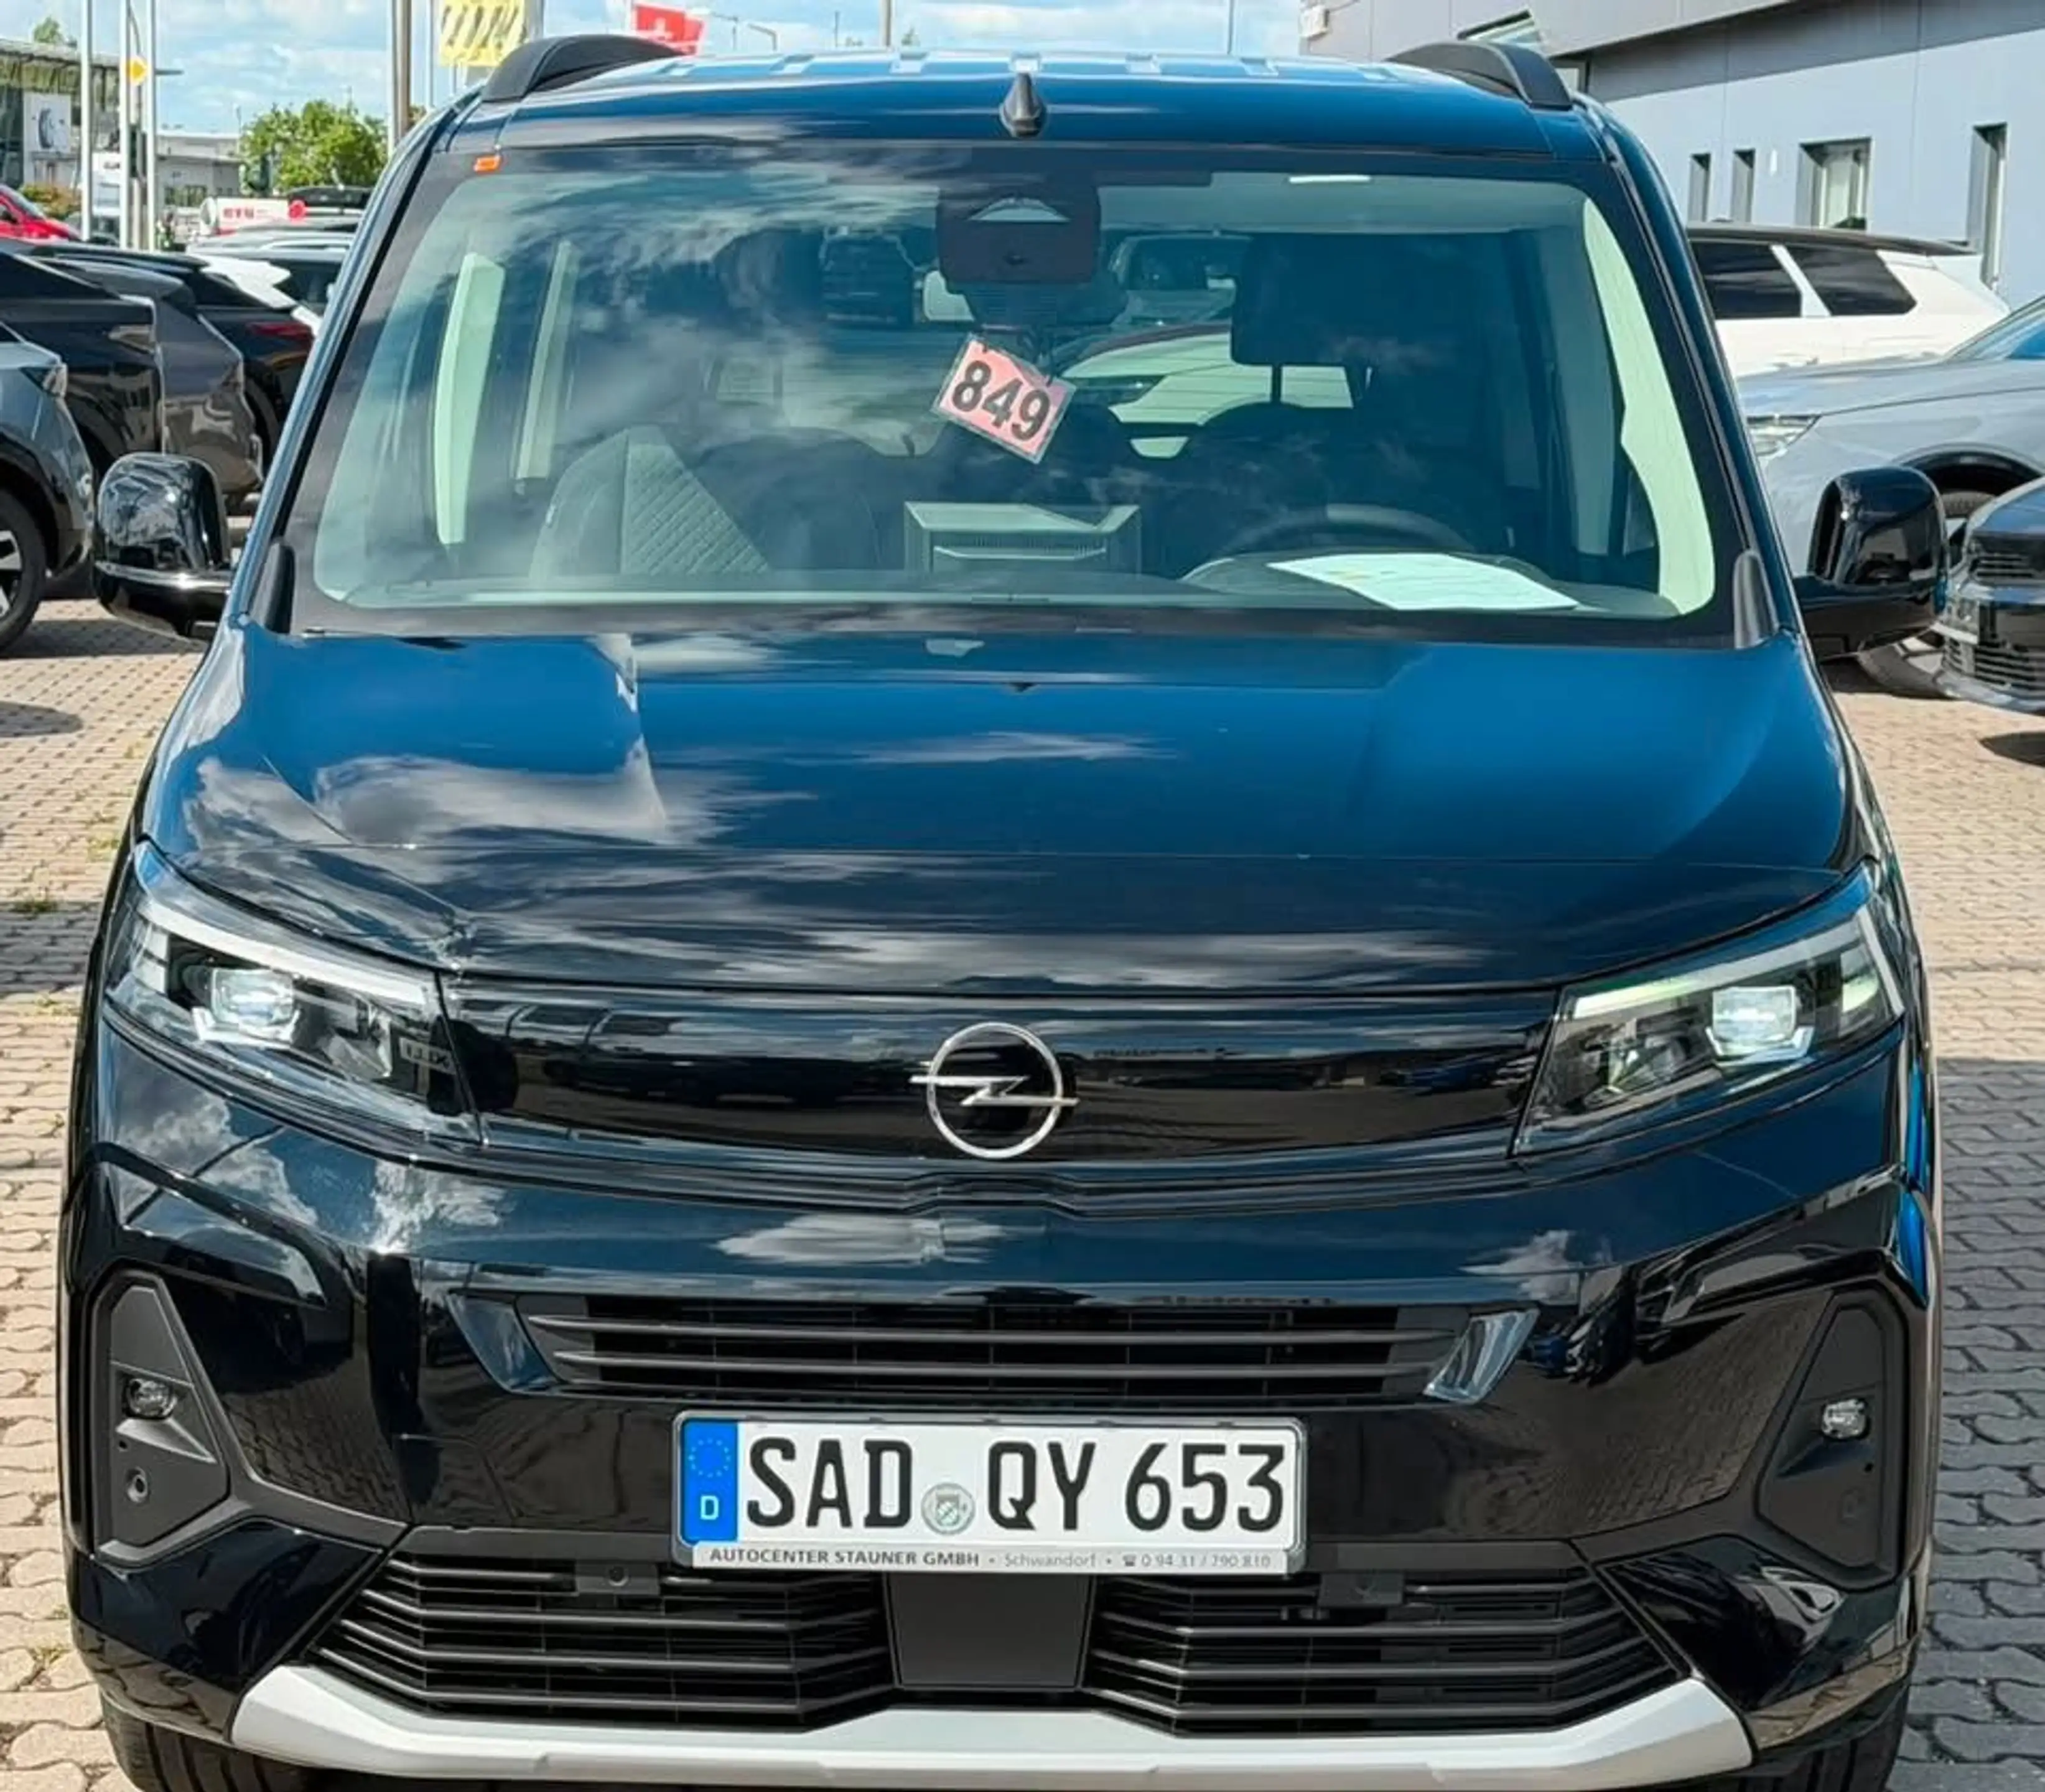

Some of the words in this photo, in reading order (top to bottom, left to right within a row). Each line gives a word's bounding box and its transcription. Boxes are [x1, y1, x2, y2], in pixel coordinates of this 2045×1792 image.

[951, 360, 1051, 441] 849
[701, 1495, 719, 1519] D
[747, 1437, 913, 1528] SAD
[988, 1442, 1096, 1531] QY
[1125, 1443, 1284, 1533] 653
[710, 1549, 829, 1564] AUTOCENTER
[835, 1551, 916, 1564] STAUNER
[923, 1552, 979, 1566] GMBH
[1005, 1552, 1096, 1567] Schwandorf
